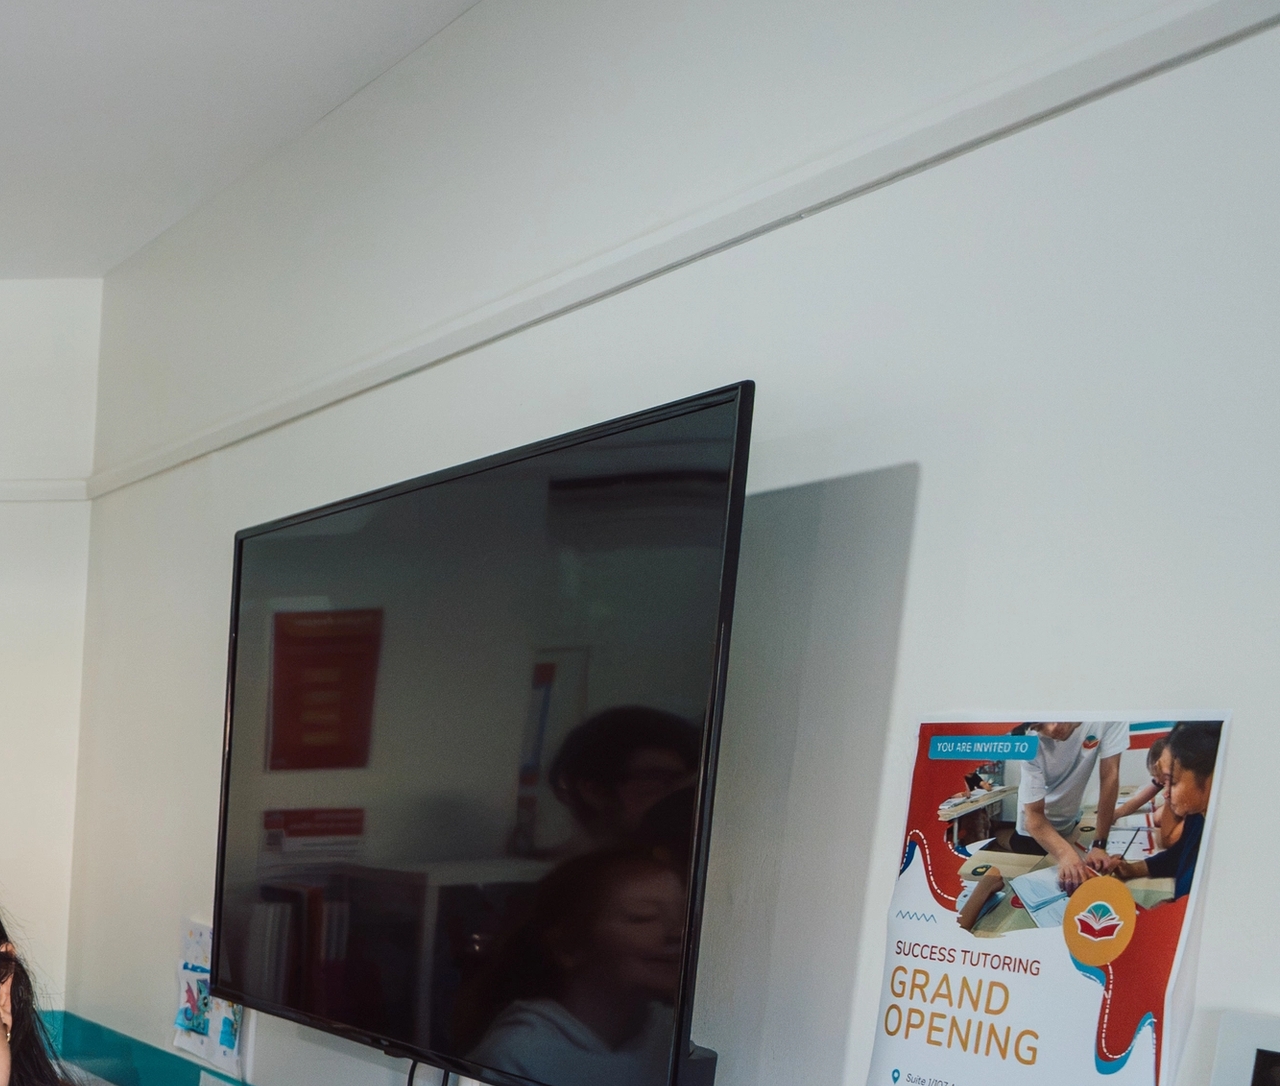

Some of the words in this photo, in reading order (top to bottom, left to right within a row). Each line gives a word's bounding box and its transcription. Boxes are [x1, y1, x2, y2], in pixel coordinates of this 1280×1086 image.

[937, 742, 954, 752] YOU
[956, 742, 972, 752] ARE
[973, 742, 1011, 753] INVITED
[1014, 742, 1029, 753] TO
[895, 940, 957, 963] SUCCESS
[961, 950, 1041, 976] TUTORING
[891, 965, 1010, 1016] GRAND
[884, 1003, 1039, 1066] OPENING
[906, 1073, 926, 1086] Suite
